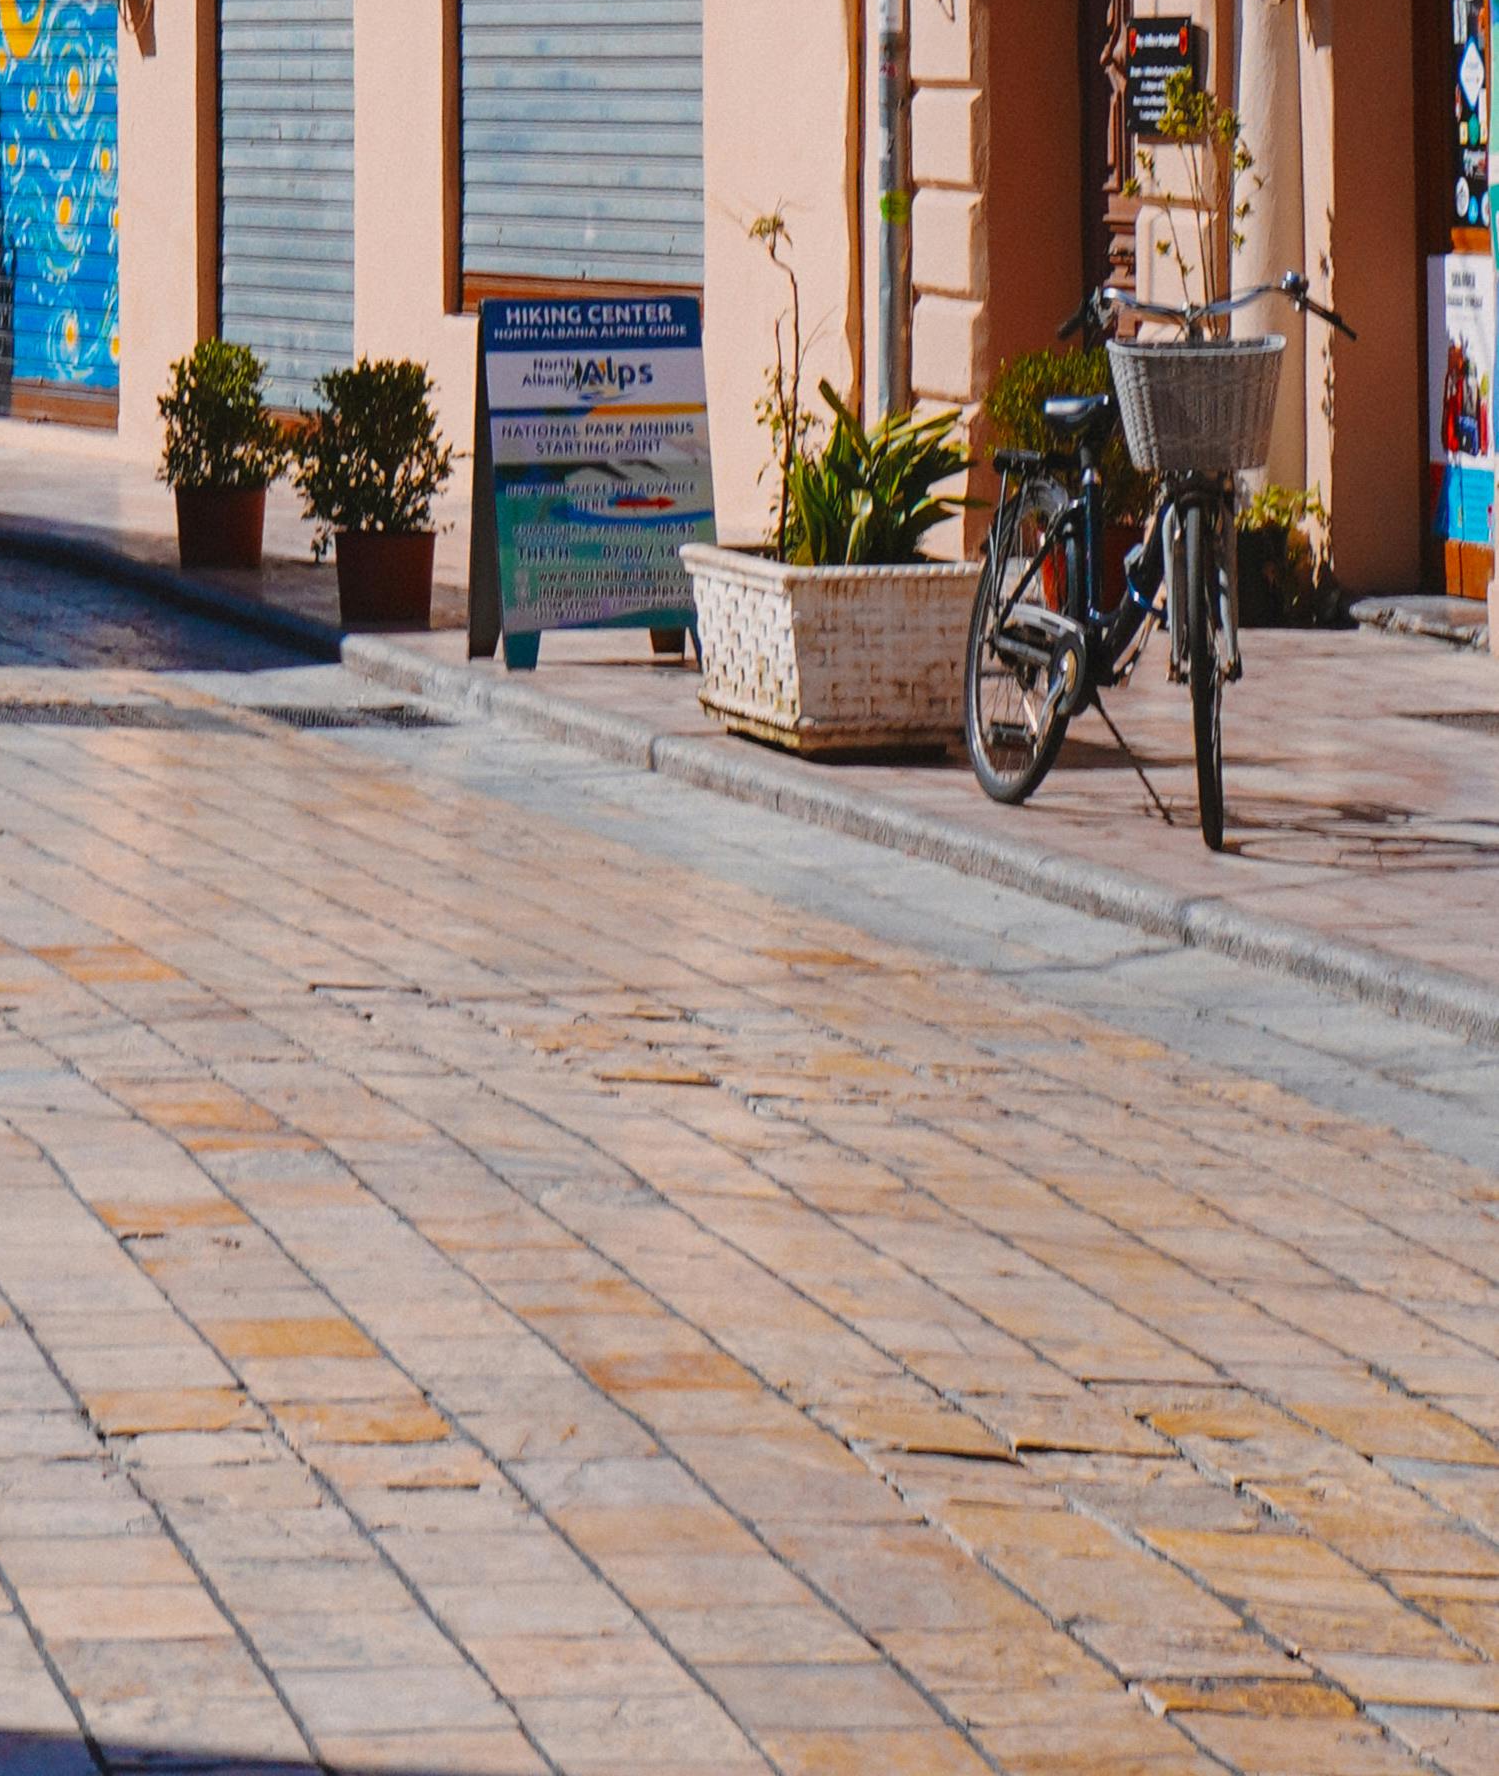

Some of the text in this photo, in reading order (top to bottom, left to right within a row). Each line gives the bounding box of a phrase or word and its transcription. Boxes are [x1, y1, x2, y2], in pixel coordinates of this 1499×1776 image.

[506, 302, 672, 326] HIKING CENTER
[493, 323, 687, 341] NORTH ALBANIA ALPINE GUIDE
[533, 356, 575, 370] North
[522, 372, 579, 390] Albania
[581, 355, 654, 391] Alps
[501, 420, 694, 440] NATIONAL PARK MINIBUS
[536, 438, 662, 457] STARTING POINT
[636, 479, 695, 494] ADVANCE
